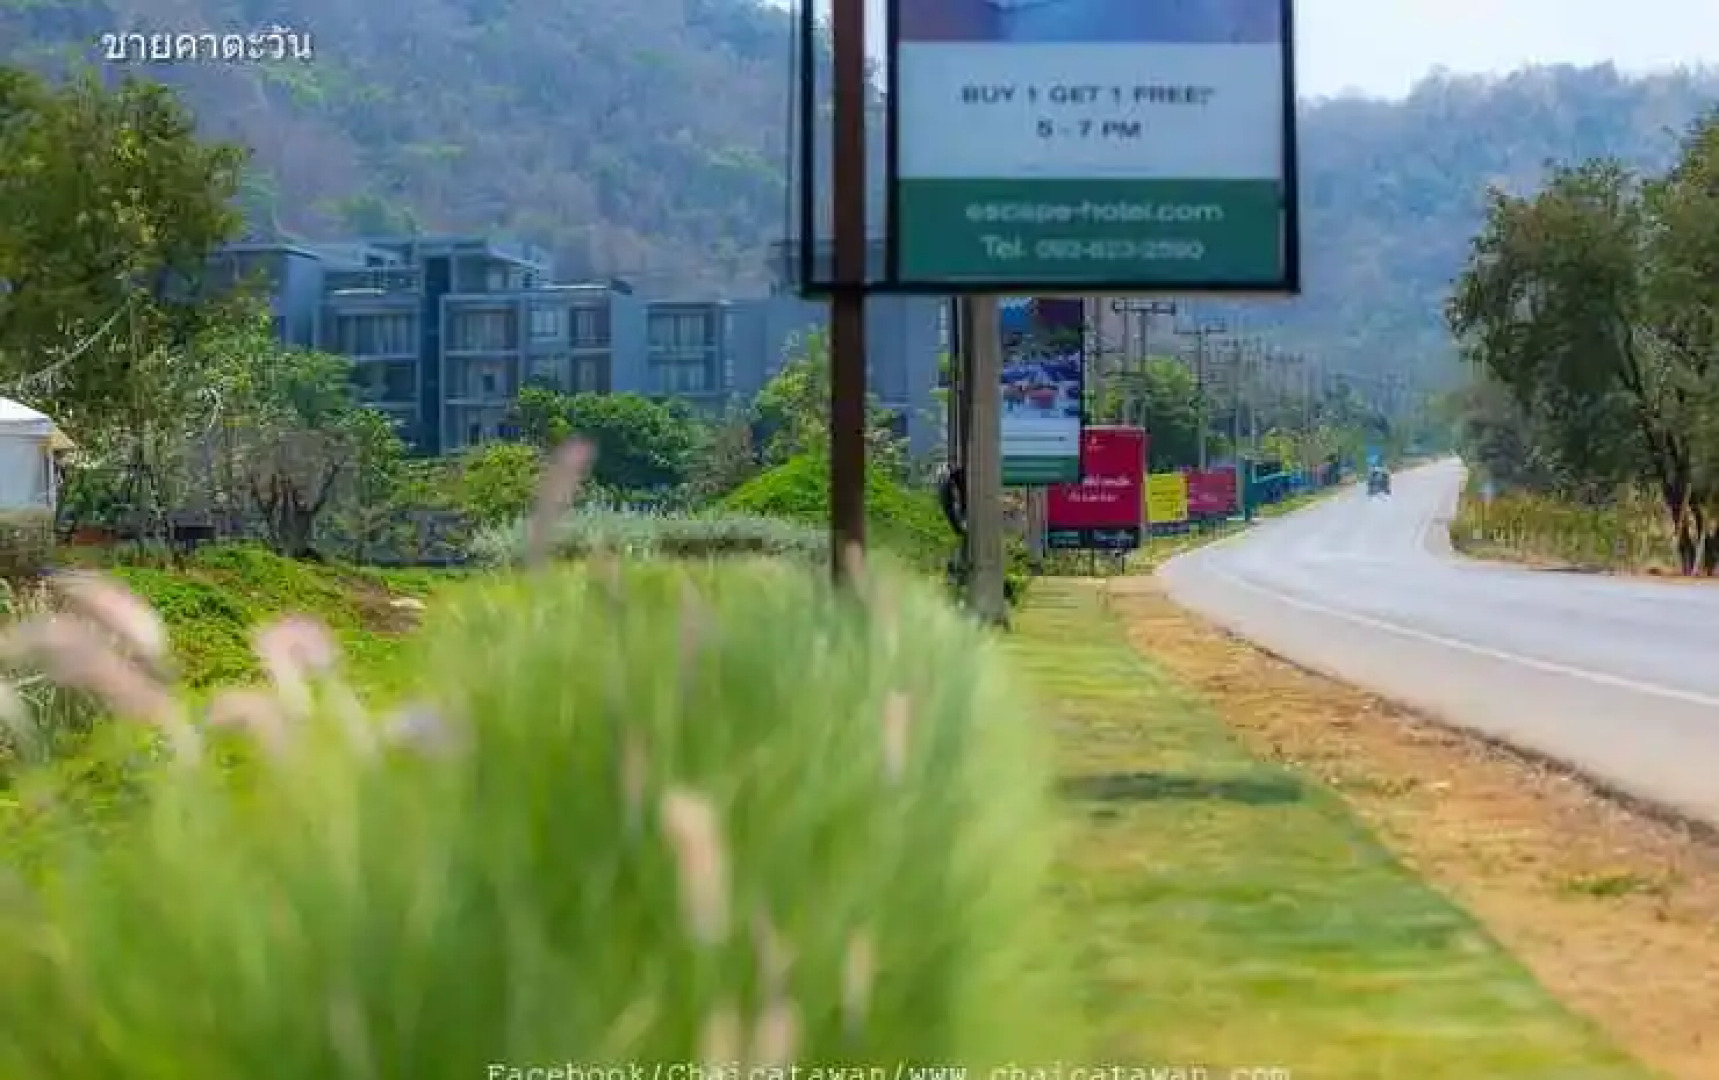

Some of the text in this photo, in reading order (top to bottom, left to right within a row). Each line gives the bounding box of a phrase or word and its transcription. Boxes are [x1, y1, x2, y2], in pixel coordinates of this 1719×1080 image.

[961, 85, 1015, 104] BUY
[1048, 85, 1102, 104] GET
[1036, 119, 1053, 138] 5
[1077, 119, 1092, 138] 7
[1101, 119, 1142, 138] PM
